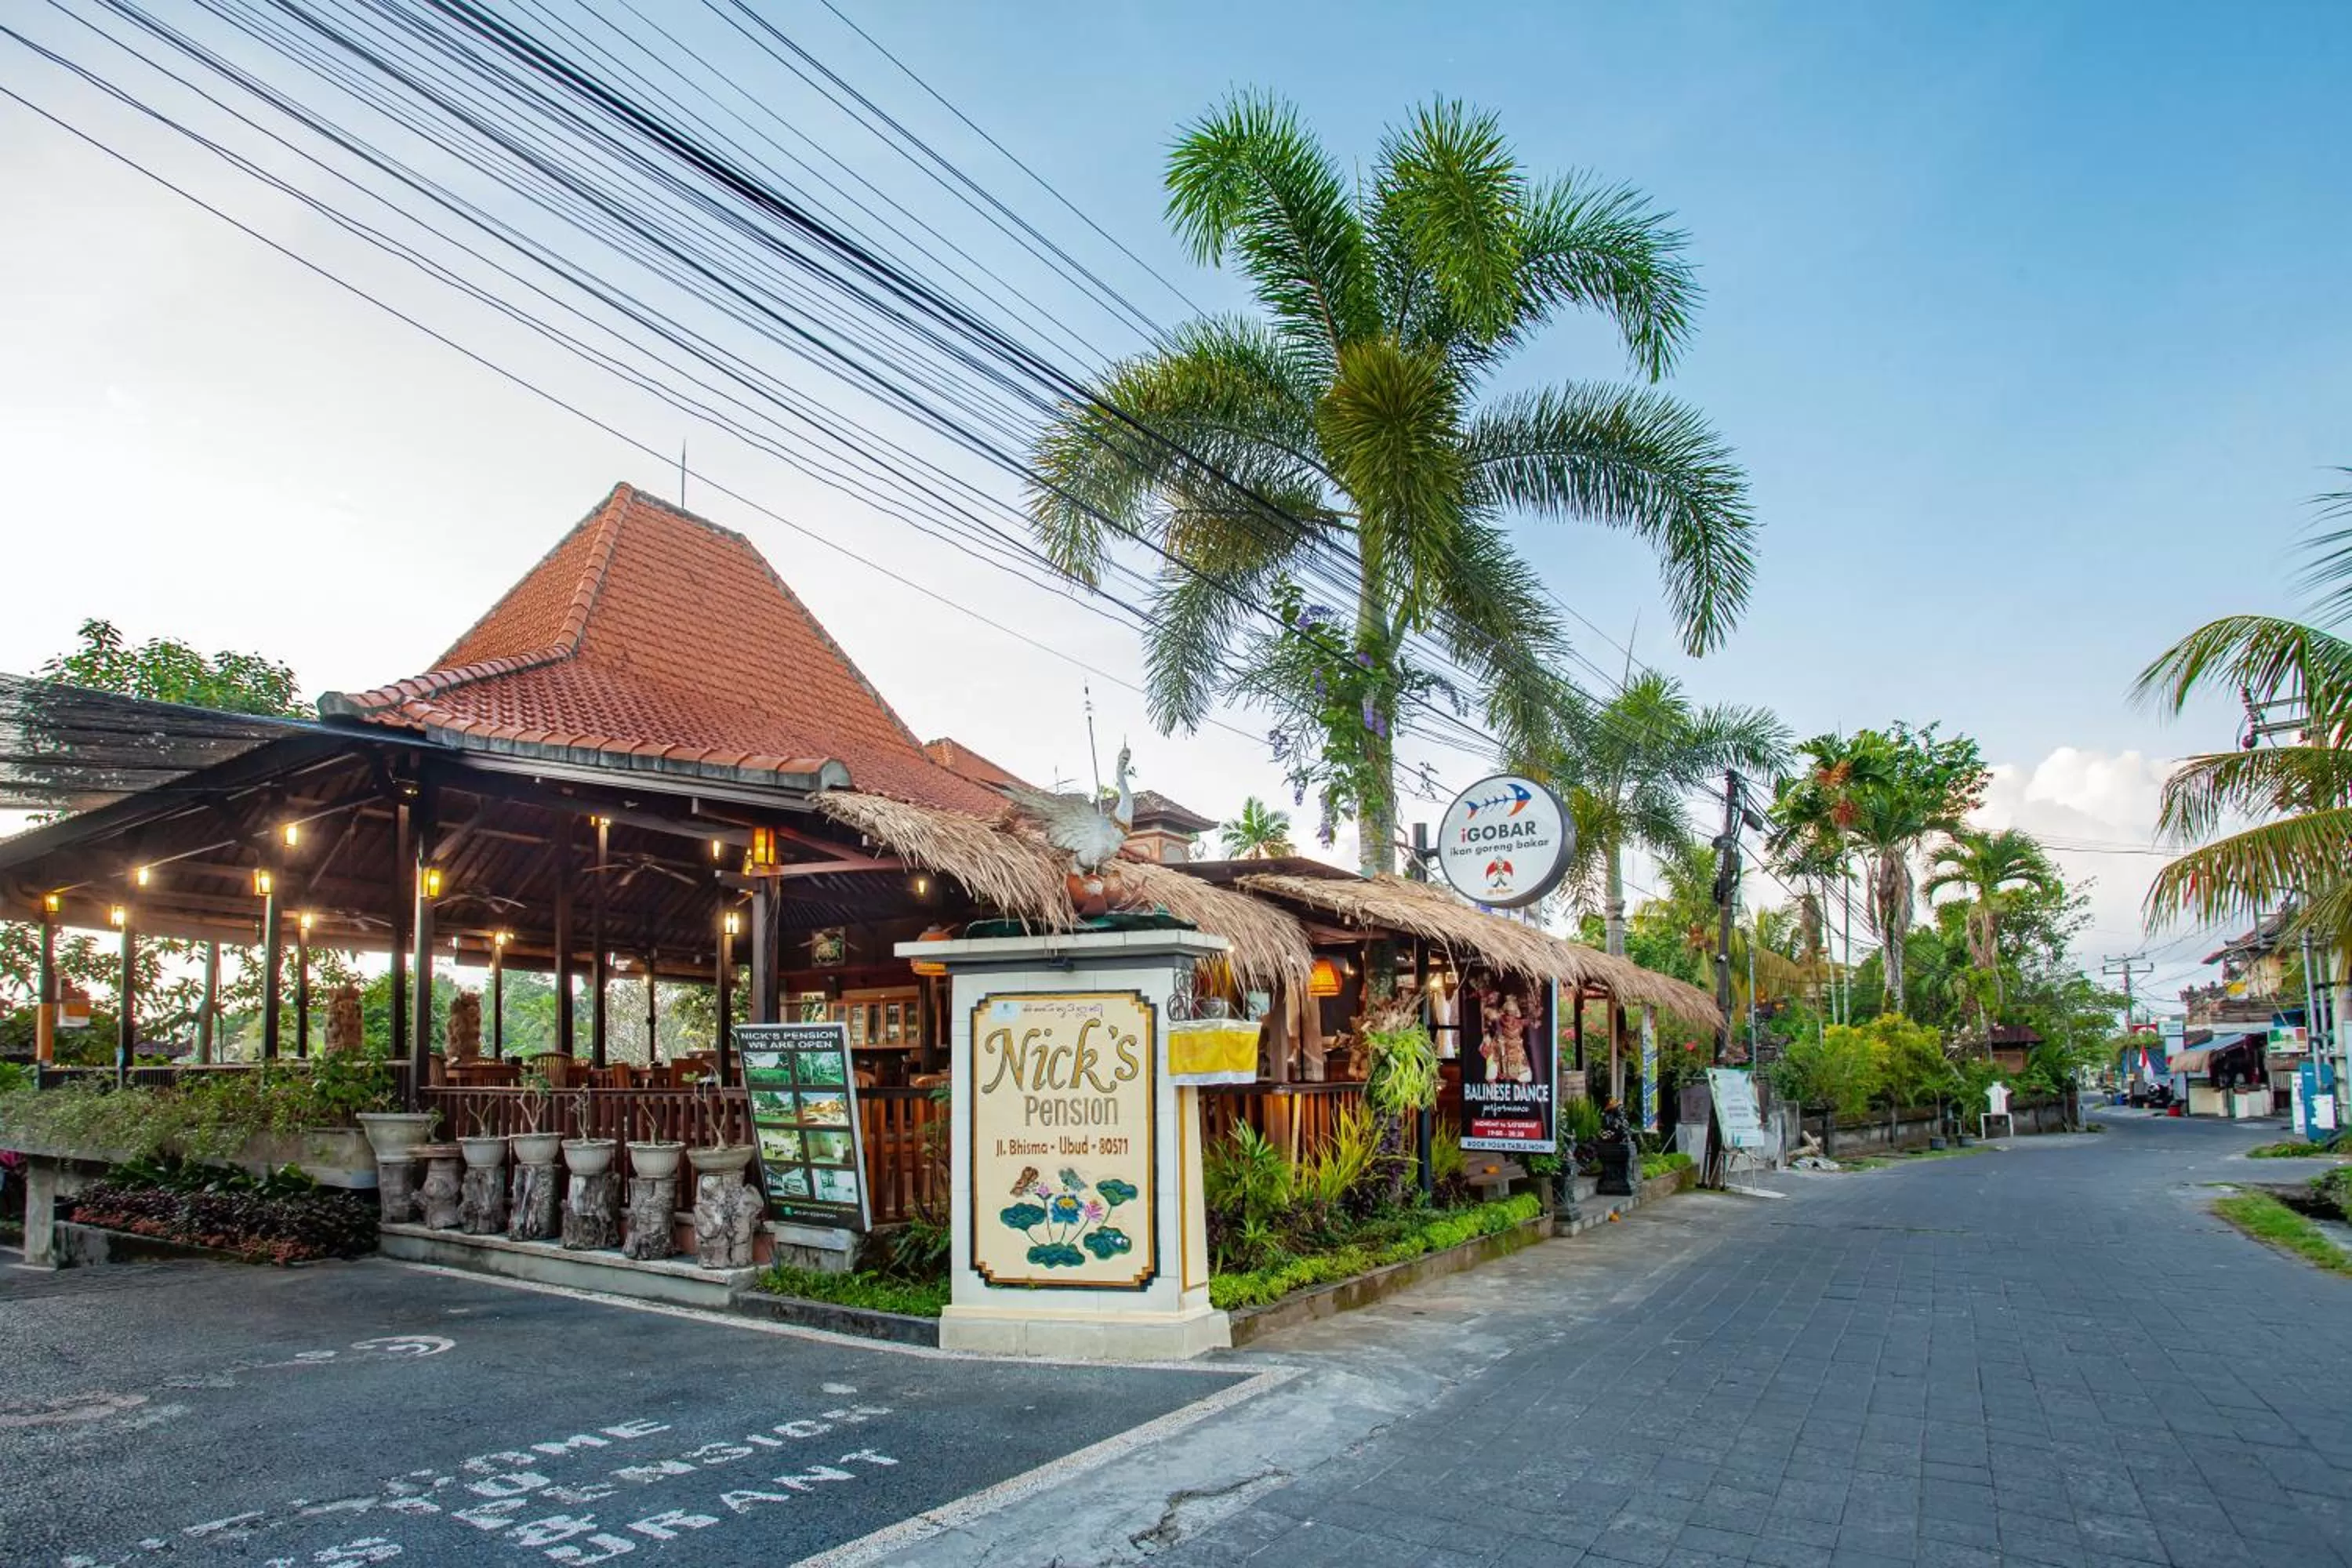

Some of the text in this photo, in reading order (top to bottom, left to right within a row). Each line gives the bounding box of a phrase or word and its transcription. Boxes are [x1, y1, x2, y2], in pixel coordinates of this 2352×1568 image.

[1461, 820, 1537, 844] iGOBAR
[1450, 838, 1549, 857] ikan goreng bakar
[741, 1030, 839, 1040] NICK'S PENSION
[748, 1040, 833, 1049] WE ARE OPEN
[982, 1018, 1140, 1094] Nick's
[1464, 1083, 1549, 1102] BALINESE DANCE
[1481, 1102, 1530, 1117] performance
[996, 1139, 1007, 1156] Jl.
[1009, 1138, 1048, 1155] Bhisma
[1059, 1135, 1089, 1155] Ubud
[1098, 1137, 1129, 1155] 80571
